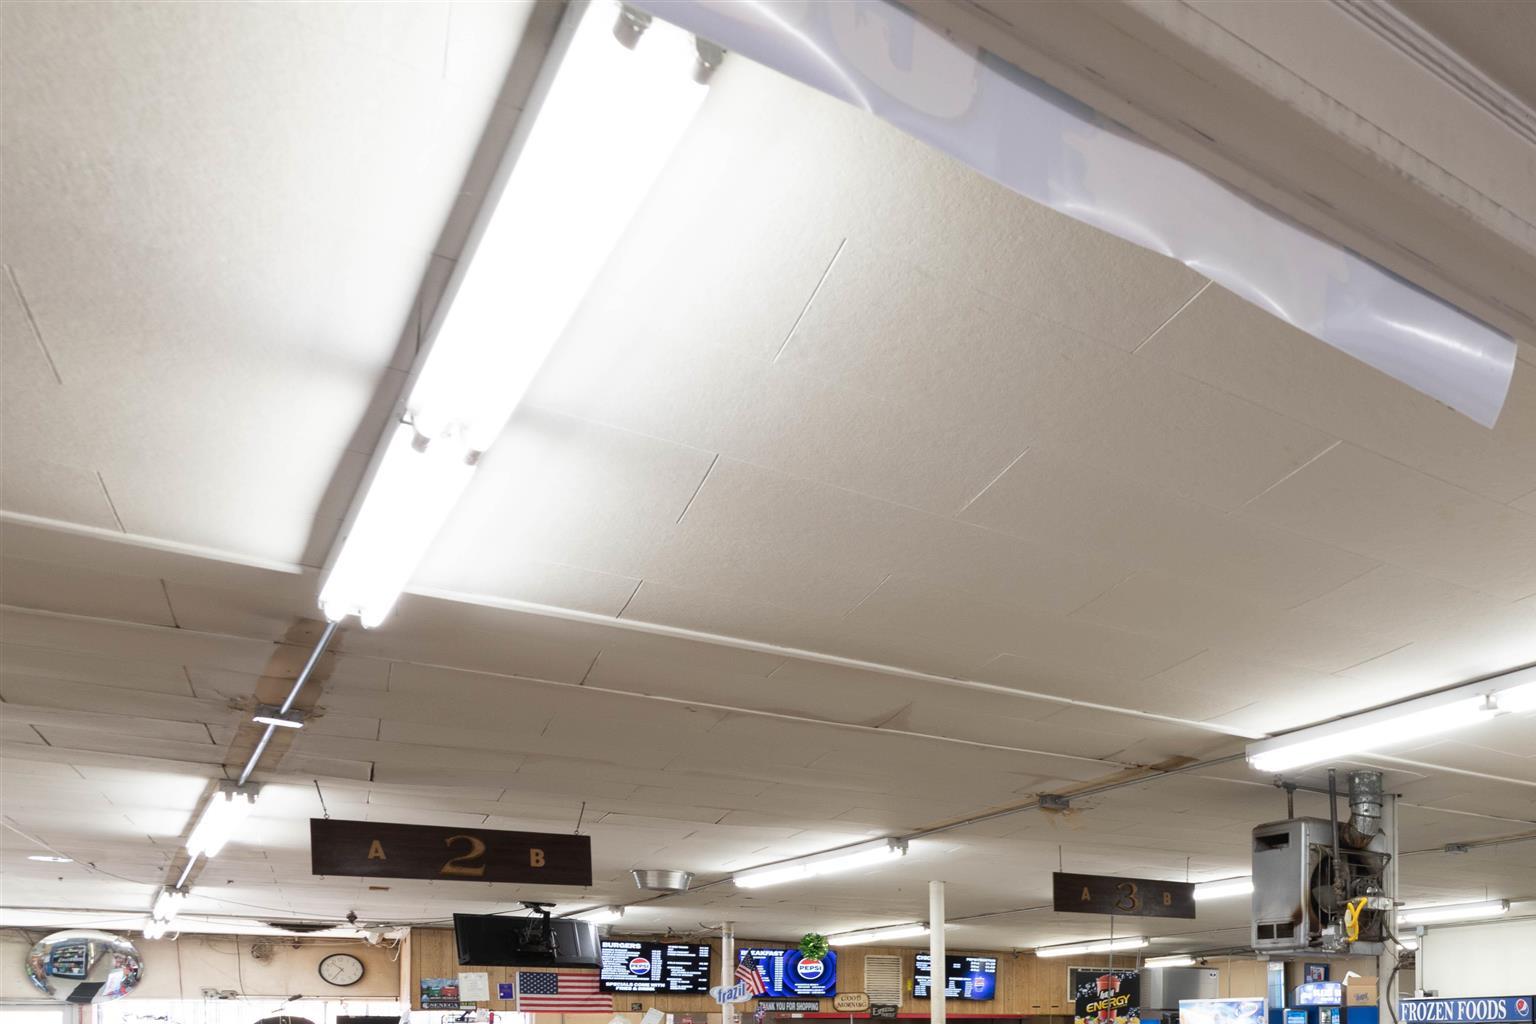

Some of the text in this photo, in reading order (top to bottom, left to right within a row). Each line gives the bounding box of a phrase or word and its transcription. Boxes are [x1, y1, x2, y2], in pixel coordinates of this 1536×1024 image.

[368, 835, 545, 877] A 2 B
[1081, 882, 1172, 913] A 3 B
[601, 941, 642, 949] BURGERS
[797, 1003, 819, 1011] SHOPPING
[1086, 994, 1131, 1013] ENERGY
[1401, 999, 1507, 1022] FROZEN FOODS
